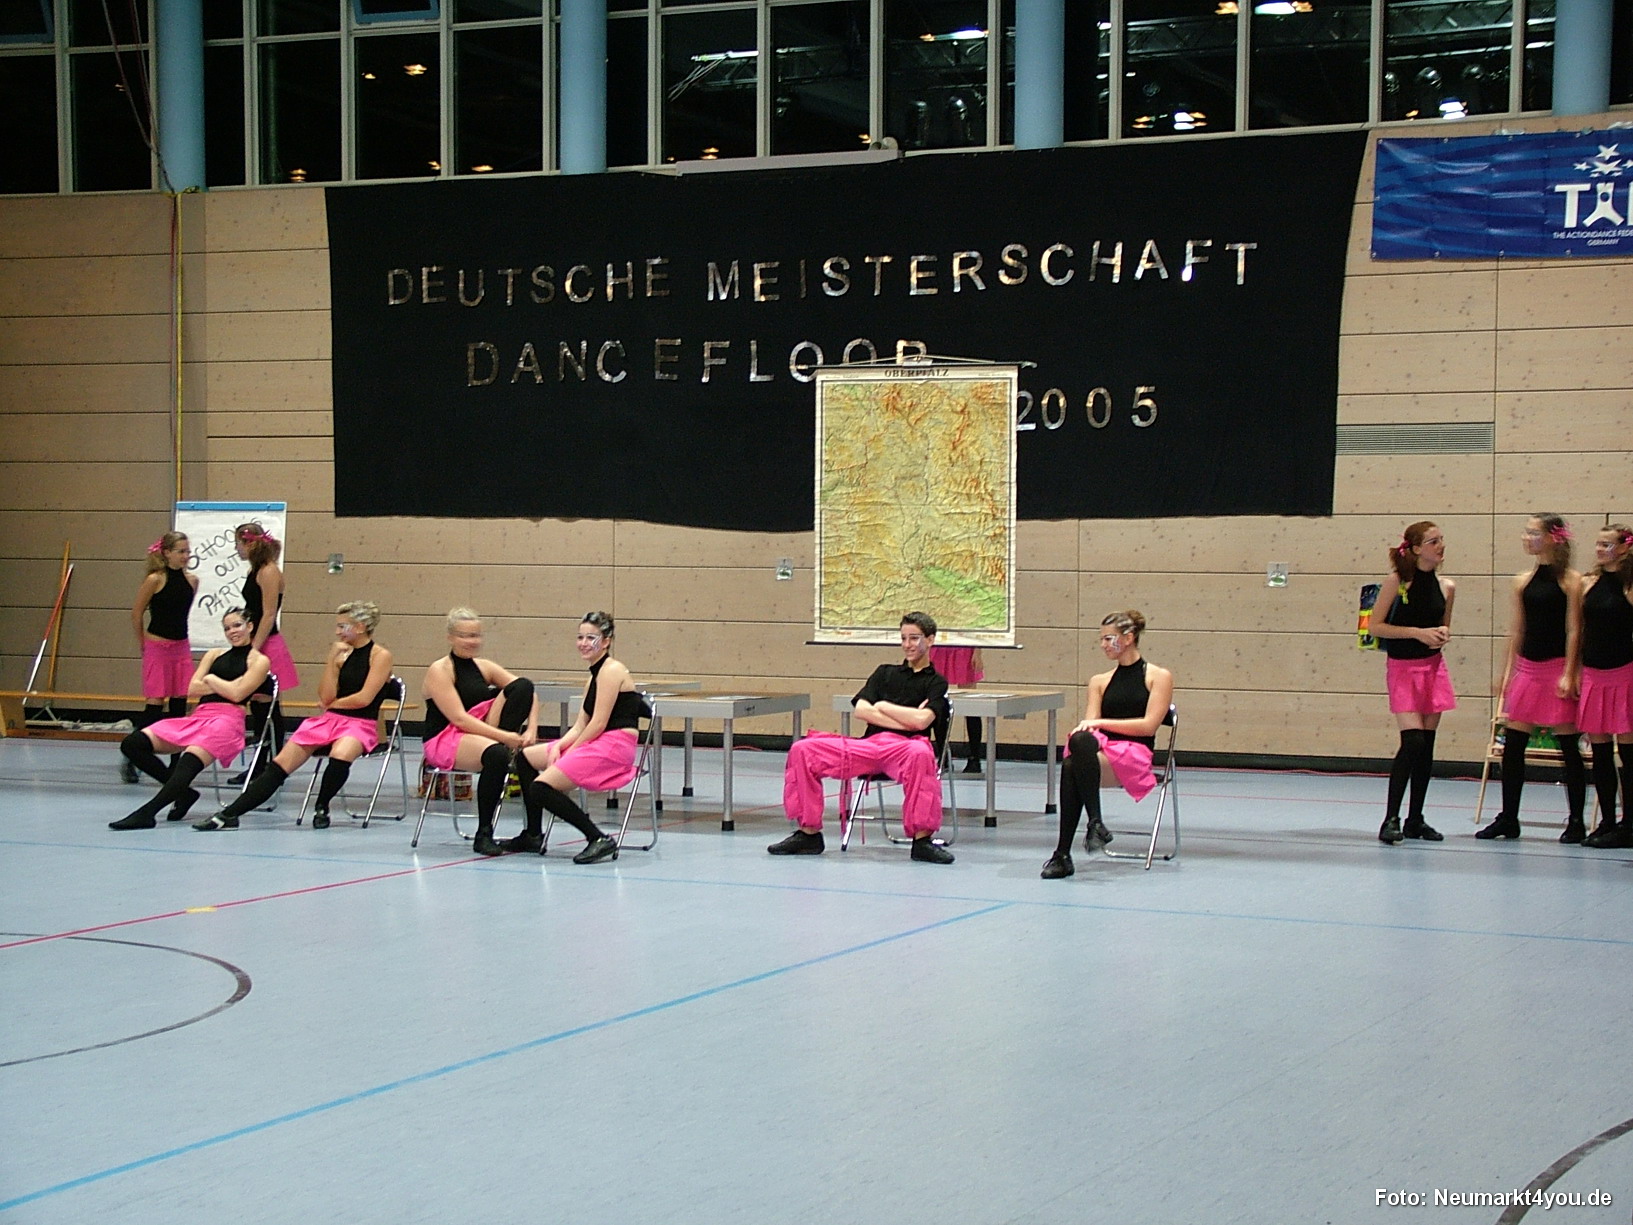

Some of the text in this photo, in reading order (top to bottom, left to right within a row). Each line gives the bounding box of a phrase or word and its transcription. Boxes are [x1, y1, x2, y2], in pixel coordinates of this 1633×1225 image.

[1554, 181, 1633, 229] TA
[1553, 231, 1566, 239] THE
[1587, 238, 1620, 247] GERMANY
[387, 239, 1258, 307] DEUTSCHE MEISTERSCHAFT
[883, 368, 950, 378] OBERPFALZ
[1016, 386, 1159, 431] 2005
[198, 576, 247, 616] PART
